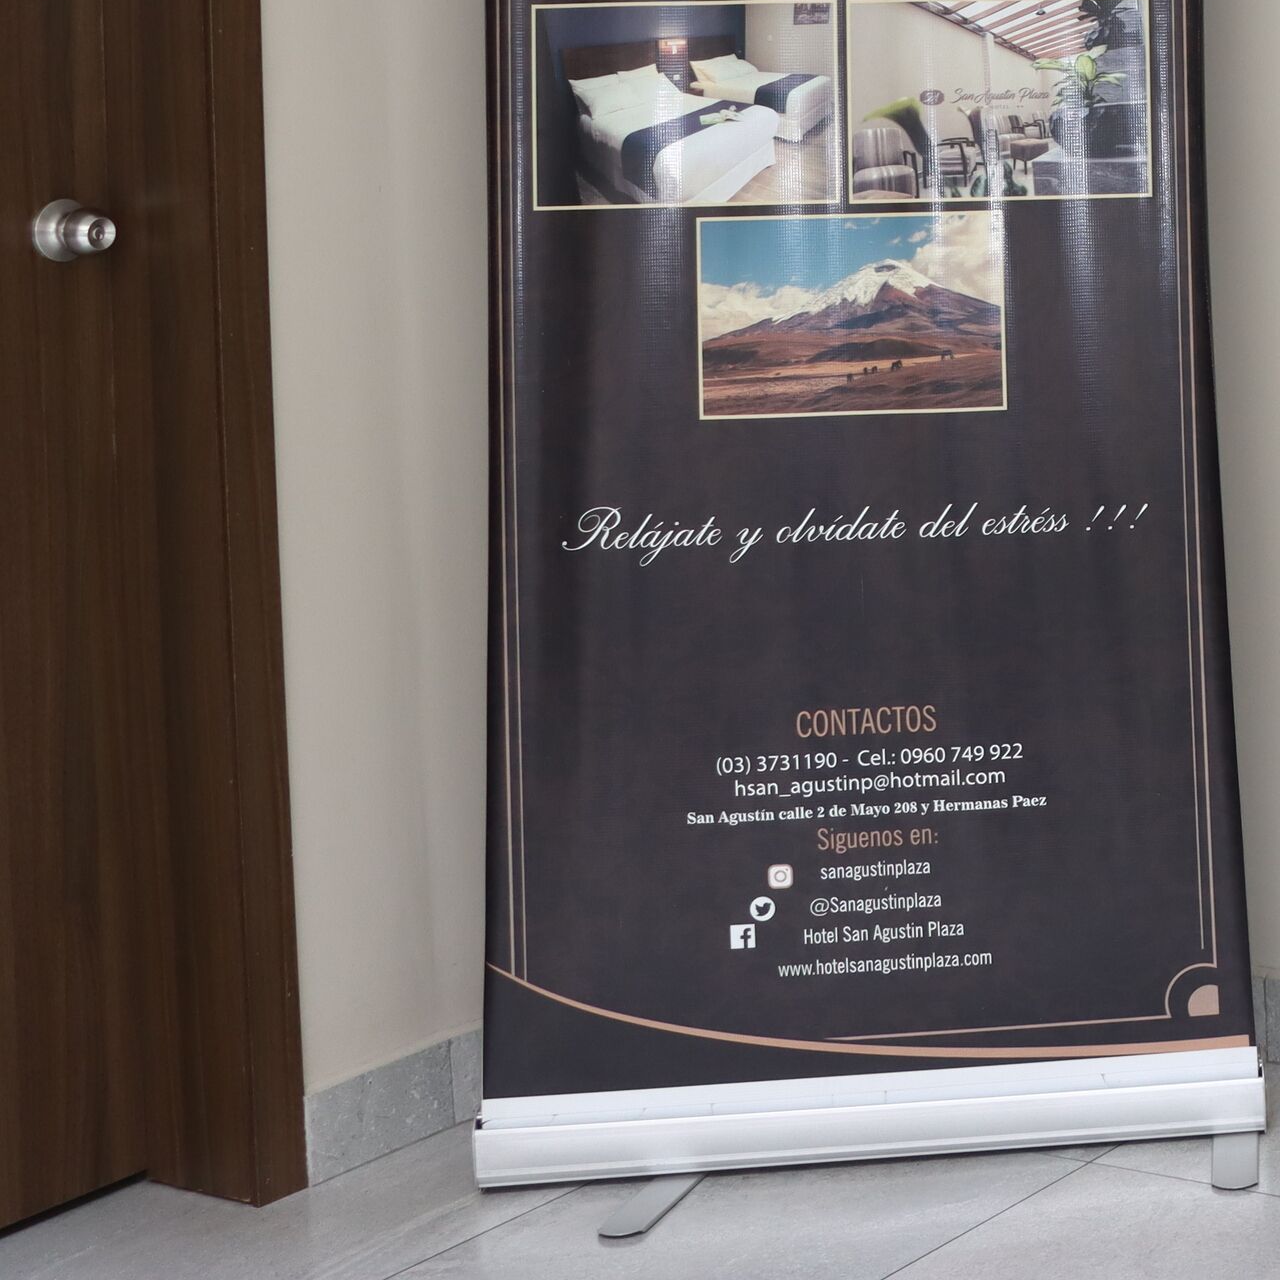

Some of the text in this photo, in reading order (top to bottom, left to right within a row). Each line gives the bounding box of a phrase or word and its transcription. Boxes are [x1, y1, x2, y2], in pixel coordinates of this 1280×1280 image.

[951, 87, 975, 104] San
[1018, 87, 1050, 102] Plaza
[562, 506, 724, 567] Relájate
[729, 526, 764, 564] y
[776, 506, 907, 543] olvídate
[919, 502, 978, 539] del
[796, 704, 937, 738] CONTACTOS
[716, 755, 752, 776] (03)
[756, 751, 838, 772] 3731190
[857, 748, 896, 767] Cel.:
[900, 747, 946, 765] 0960
[950, 745, 985, 763] 749
[989, 743, 1024, 761] 922
[734, 769, 1006, 798] hsan_agustinp@hotmail.com
[686, 795, 1047, 826] San Agustín calle 2 de Mayo 208 y Hermanas Paez
[910, 827, 940, 846] en:
[820, 858, 931, 882] sanagustinplaza
[809, 892, 942, 918] @Sanagustinplaza
[804, 927, 839, 946] Hotel
[843, 925, 869, 943] San
[928, 921, 965, 938] Plaza
[777, 951, 993, 978] www.hotelsanagustinplaza.com
